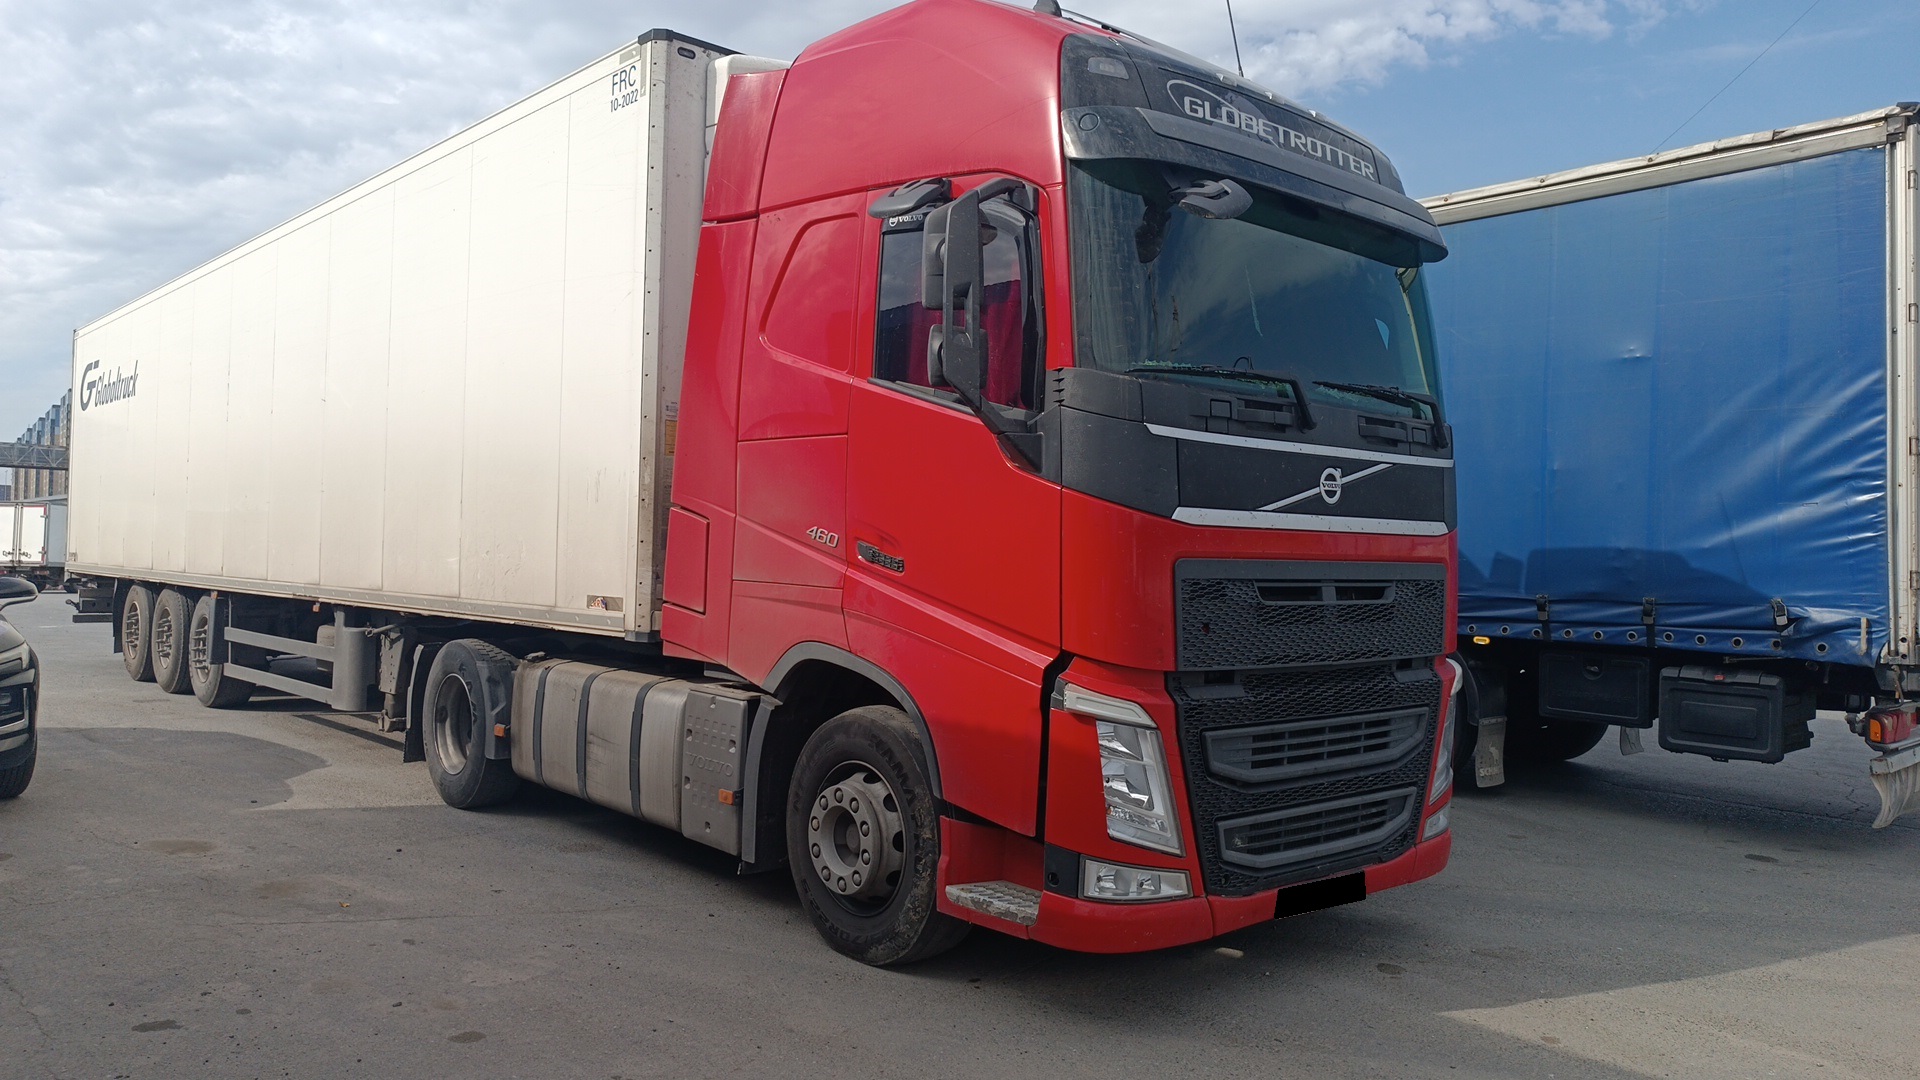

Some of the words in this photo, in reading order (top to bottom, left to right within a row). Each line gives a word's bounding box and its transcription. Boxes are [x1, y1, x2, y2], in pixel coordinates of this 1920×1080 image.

[612, 65, 637, 96] FRC
[611, 89, 639, 113] 10-2022
[1183, 96, 1375, 181] GLOBETROTTER
[898, 214, 924, 223] VOLVO
[95, 360, 139, 408] Globaltruck
[1321, 481, 1341, 489] VOLVO
[806, 526, 839, 548] 460
[685, 751, 734, 778] VOLVO
